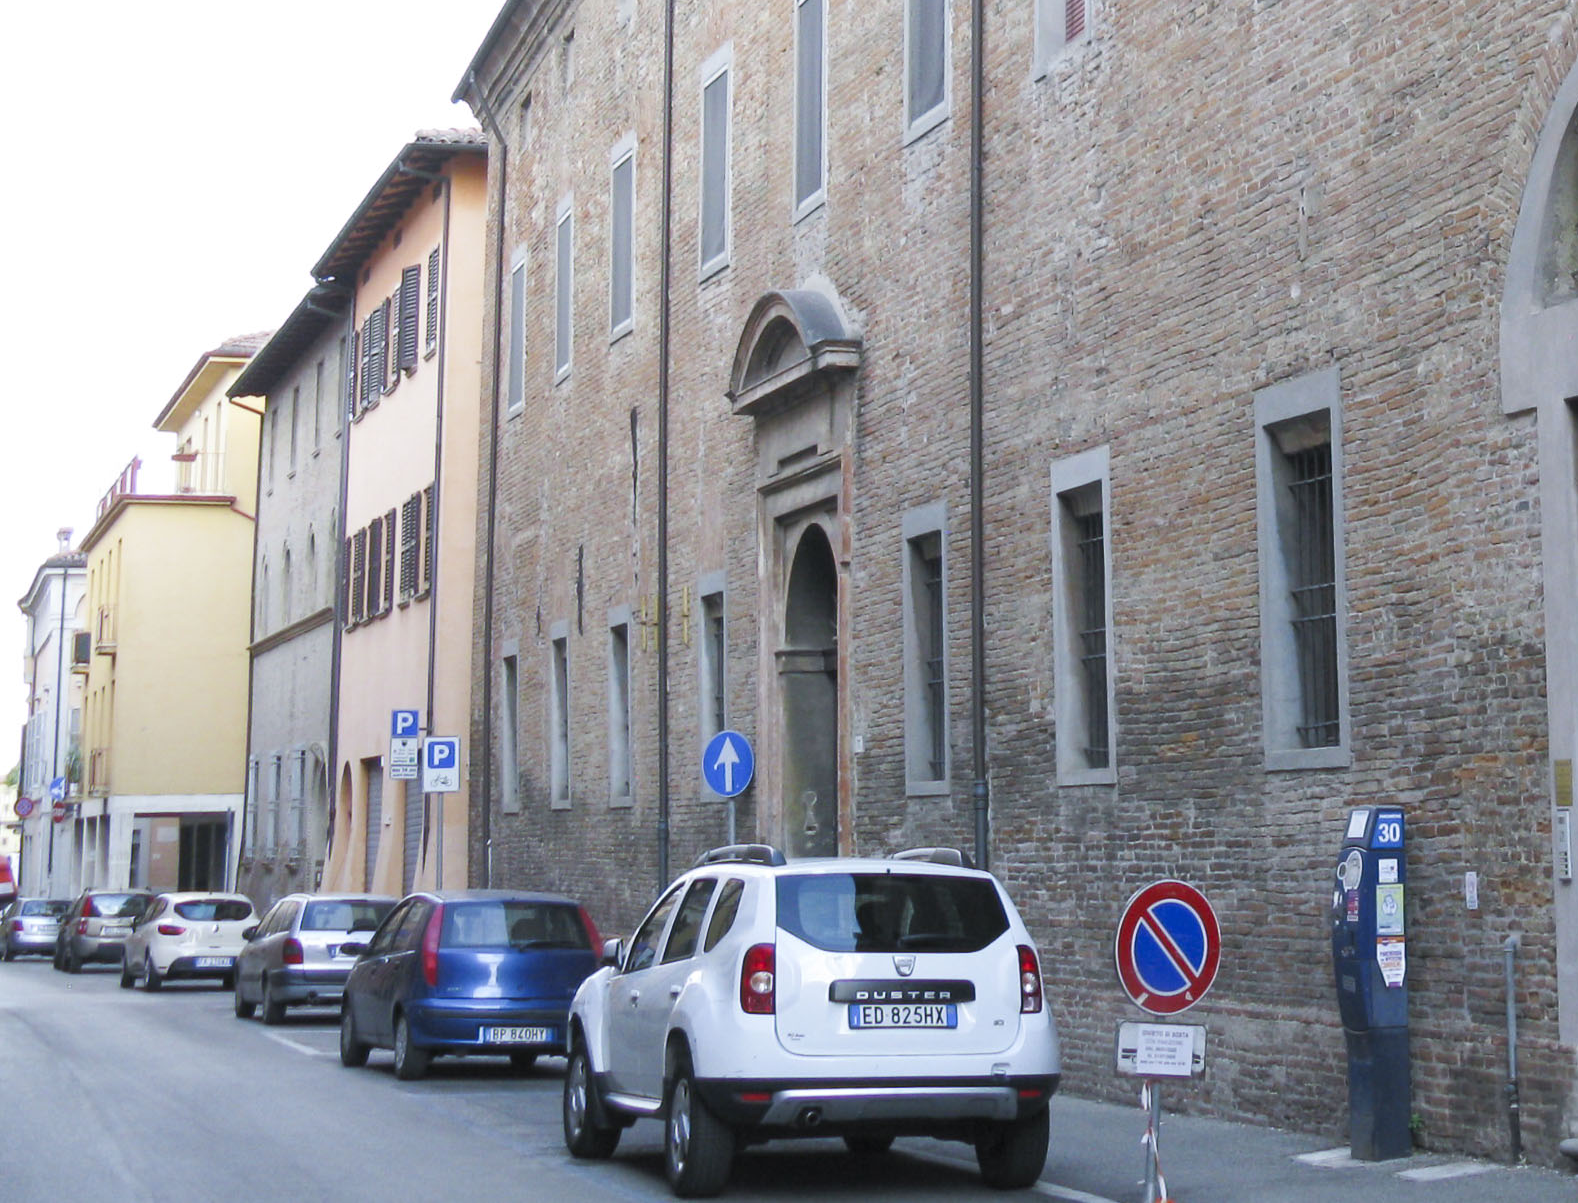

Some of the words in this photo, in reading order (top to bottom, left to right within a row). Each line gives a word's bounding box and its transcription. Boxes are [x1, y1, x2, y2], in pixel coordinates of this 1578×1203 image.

[397, 712, 414, 734] P
[433, 744, 450, 766] P
[1378, 823, 1401, 843] 30
[856, 991, 951, 999] DUSTER
[862, 1006, 884, 1024] ED
[891, 1006, 944, 1024] 825HX
